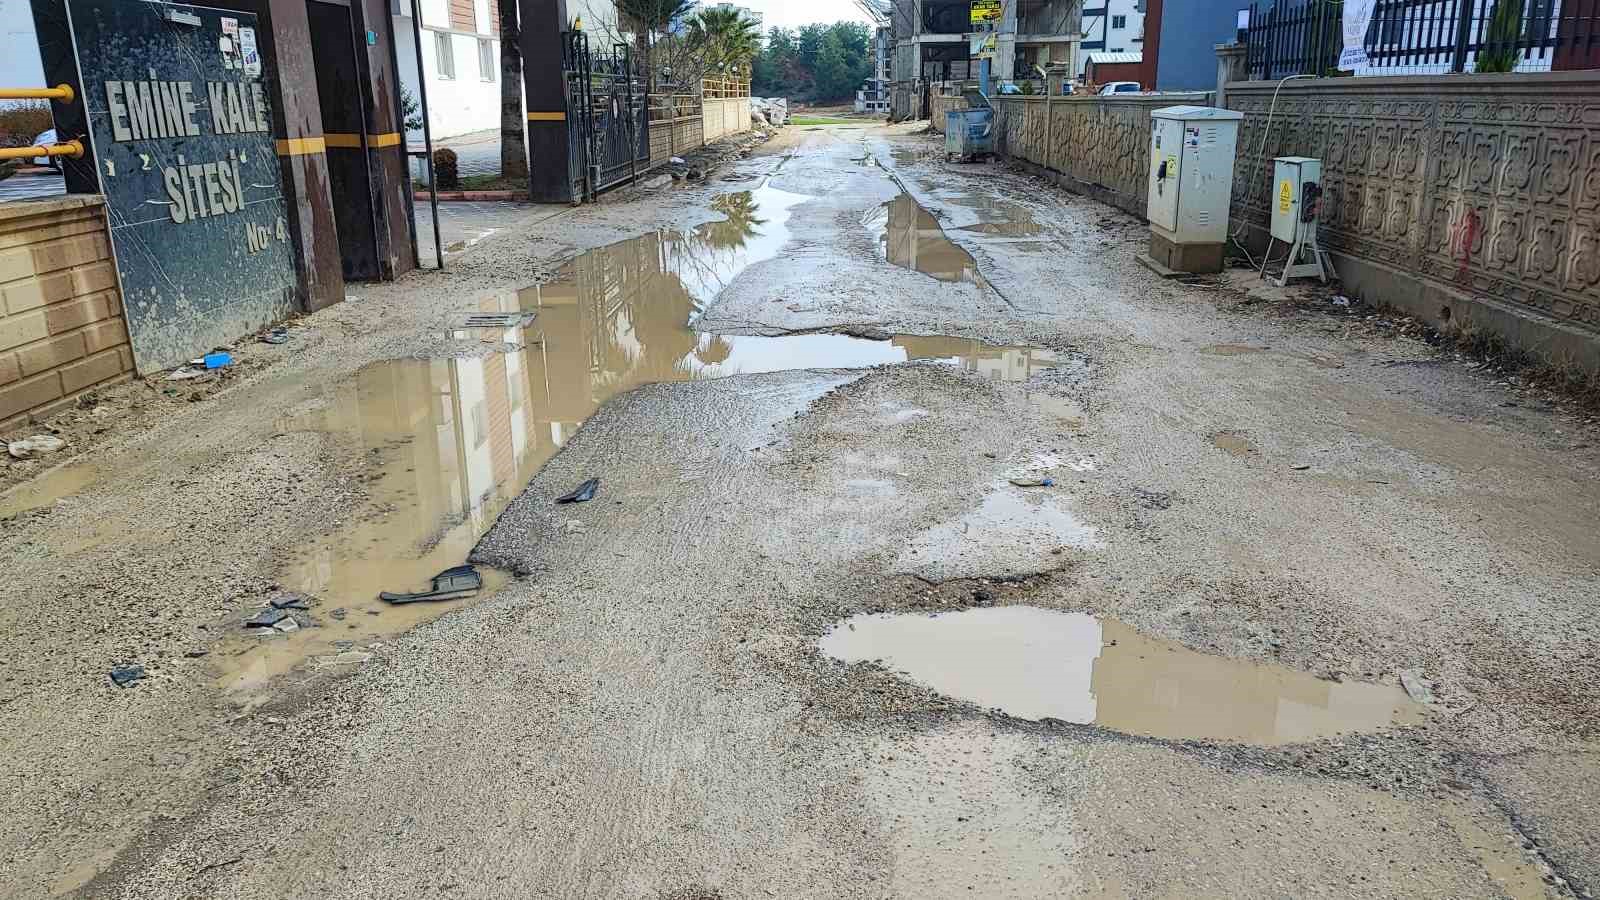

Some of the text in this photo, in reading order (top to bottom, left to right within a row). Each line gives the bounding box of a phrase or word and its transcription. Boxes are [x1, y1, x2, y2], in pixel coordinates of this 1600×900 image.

[104, 67, 269, 142] EMİNE KALE
[164, 148, 245, 224] SİTESİ
[275, 216, 290, 243] 4
